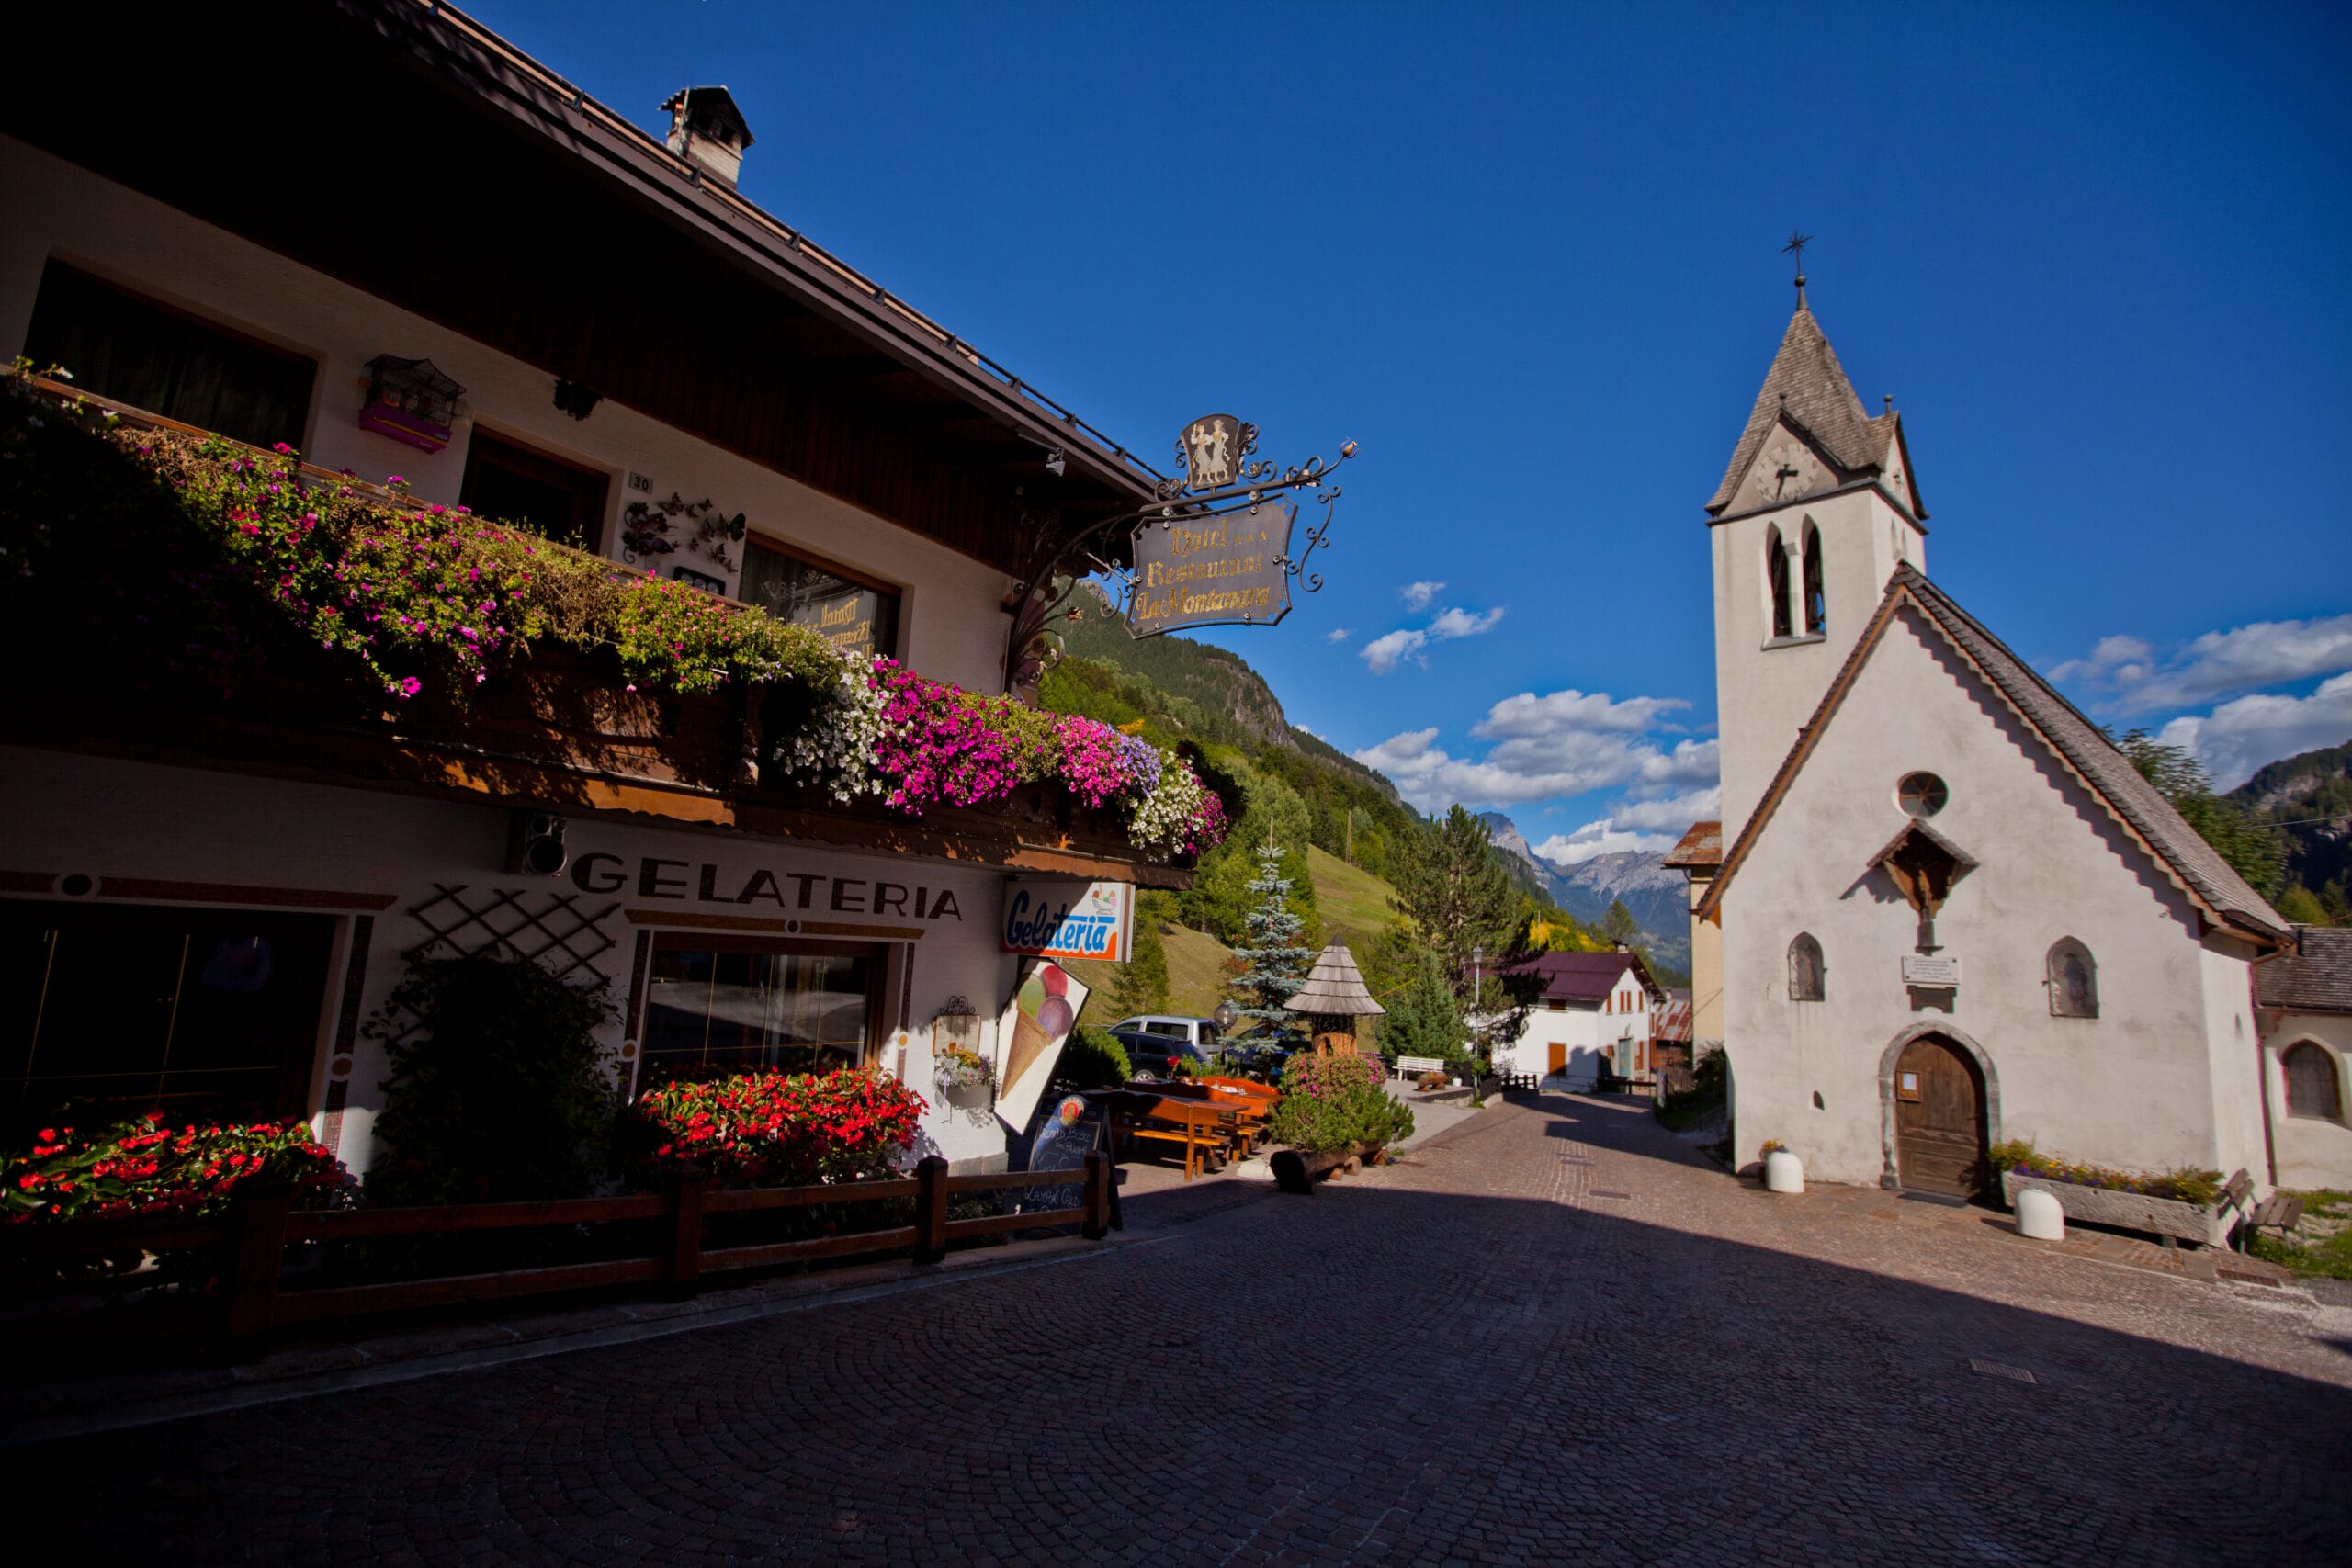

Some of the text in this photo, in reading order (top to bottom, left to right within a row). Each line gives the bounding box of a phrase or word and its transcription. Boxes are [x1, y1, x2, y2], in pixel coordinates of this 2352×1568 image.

[633, 476, 649, 491] 30
[1171, 517, 1227, 556] Hotel
[1147, 554, 1263, 588] Restaurant
[571, 852, 962, 921] GELATERIA
[1007, 889, 1116, 952] Gelateria
